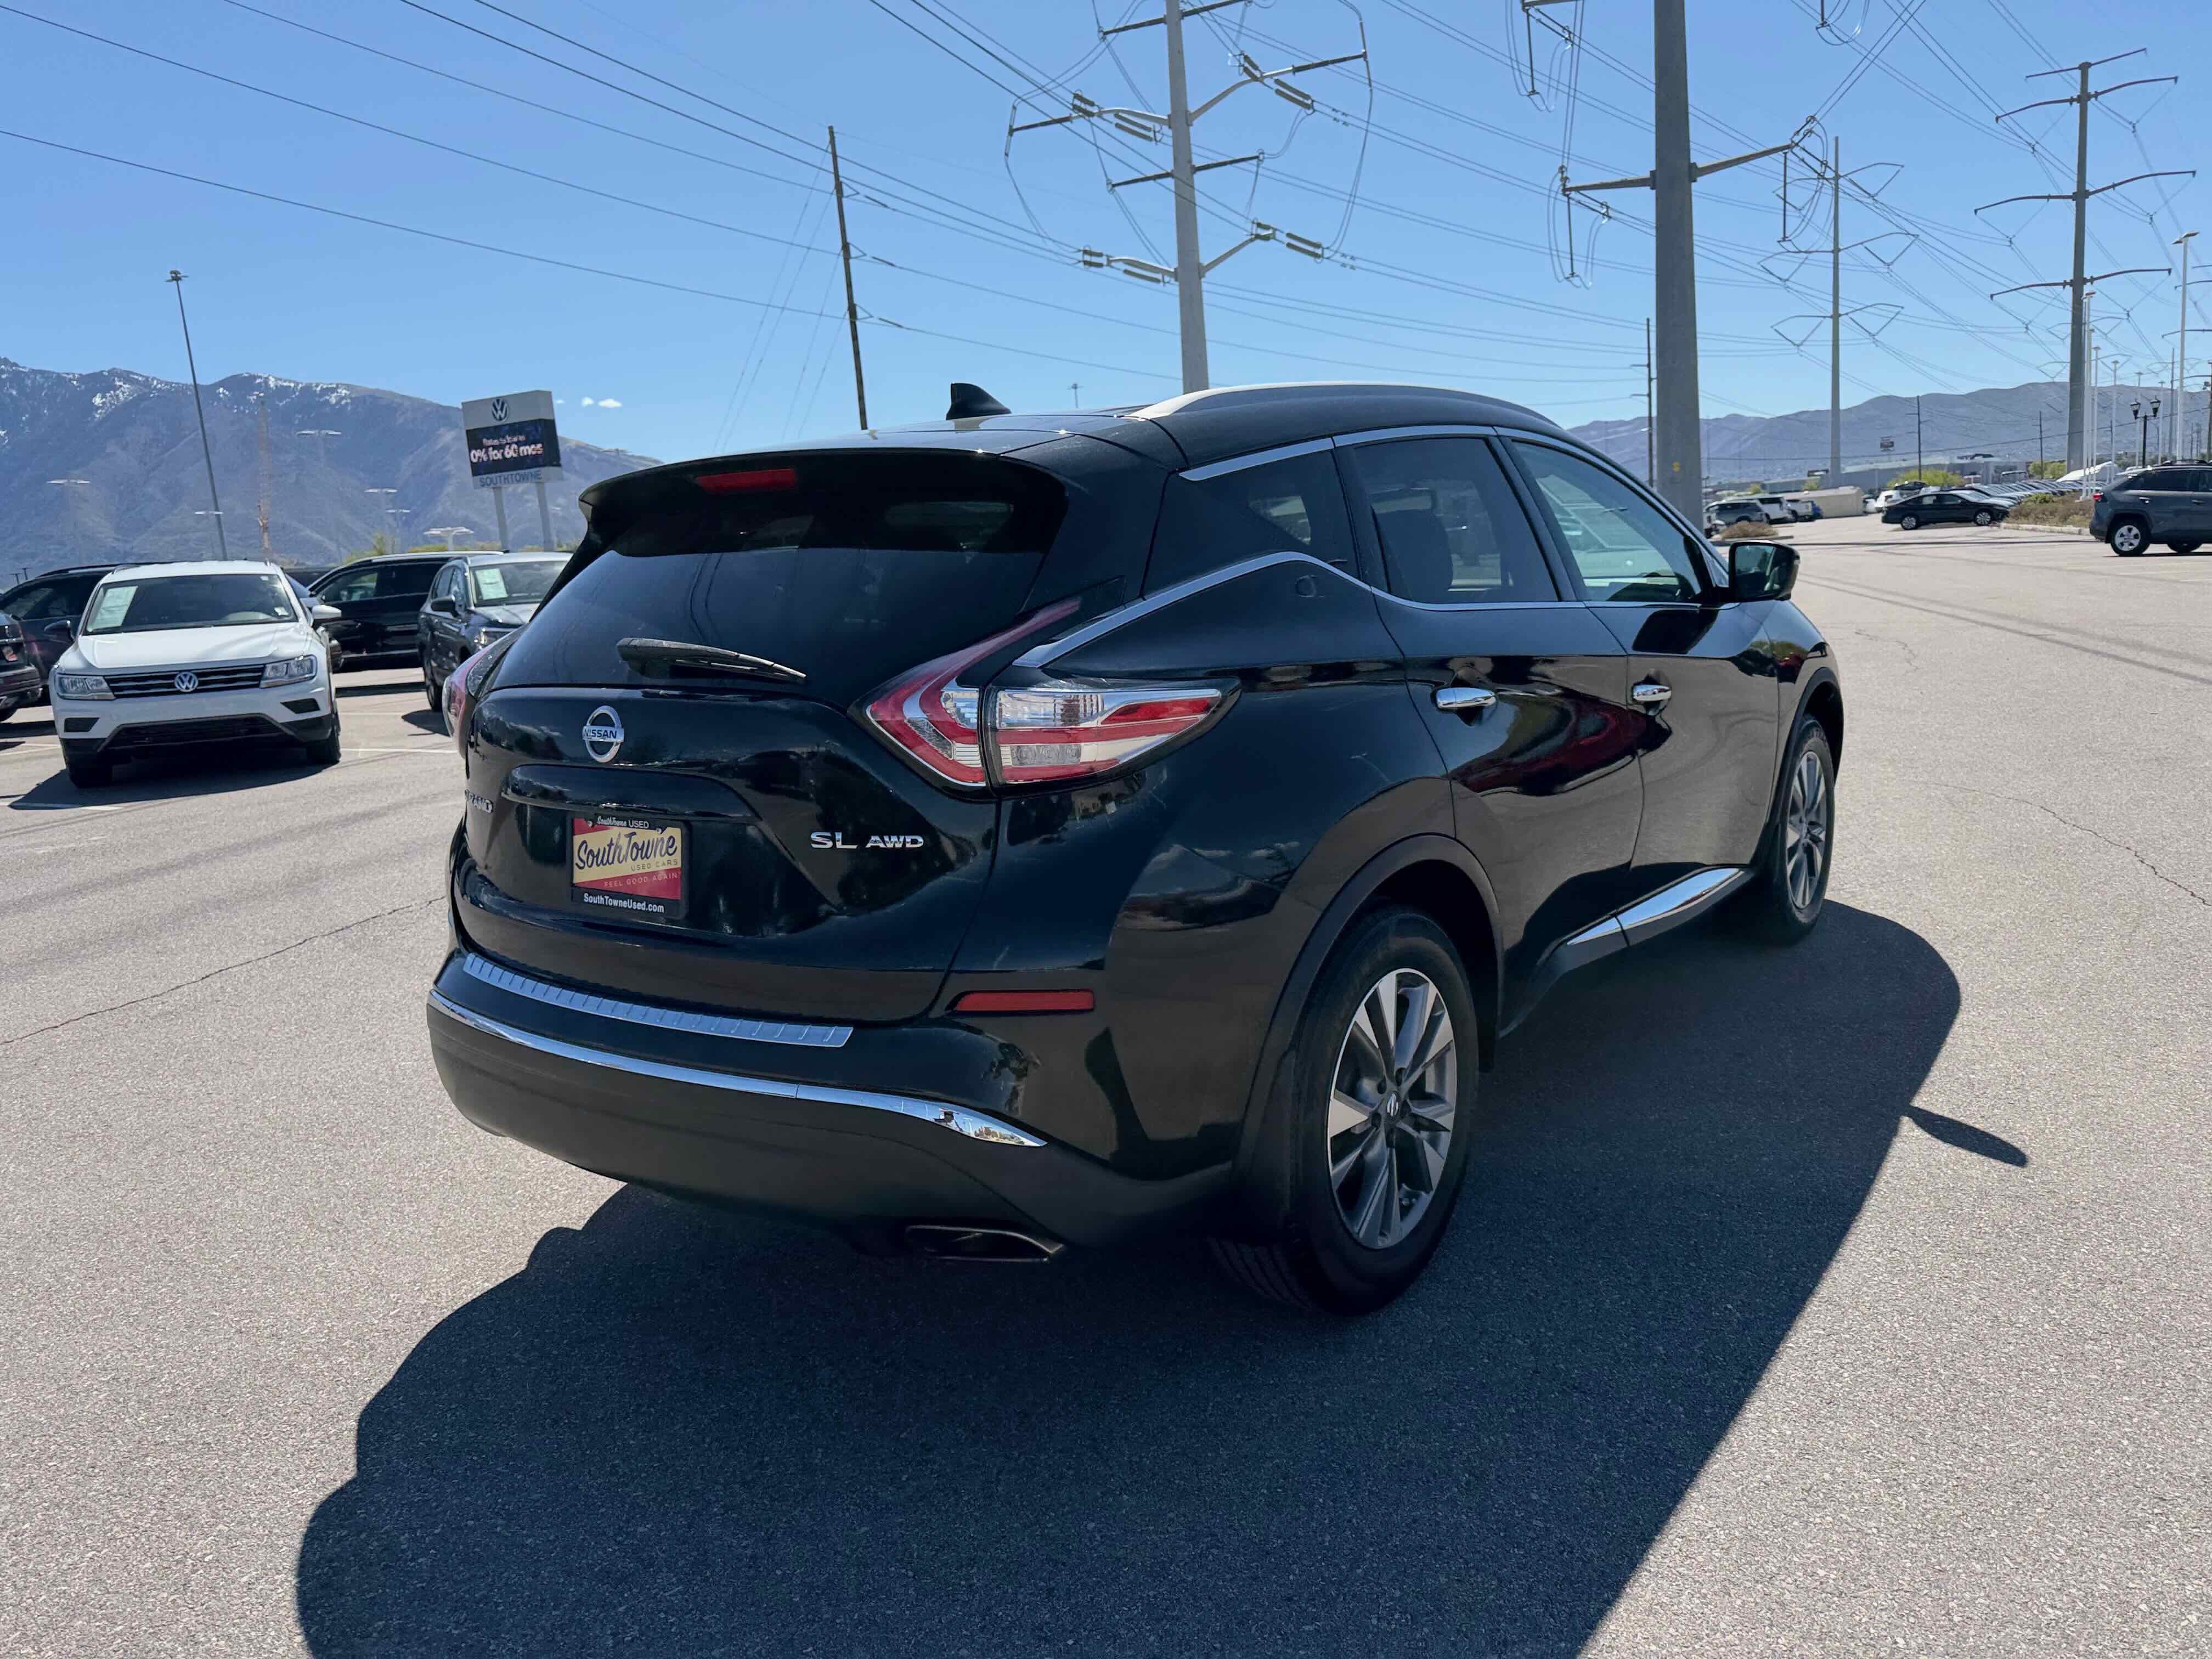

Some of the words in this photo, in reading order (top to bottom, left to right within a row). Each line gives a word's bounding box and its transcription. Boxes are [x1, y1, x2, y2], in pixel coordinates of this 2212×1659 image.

[470, 449, 488, 463] 0%
[488, 447, 503, 460] for
[504, 443, 518, 459] 60
[479, 470, 542, 487] SOUTHTOWNE
[583, 728, 617, 739] NISSAN
[628, 820, 650, 829] USED
[810, 831, 858, 849] SL
[865, 835, 924, 849] AWD
[575, 831, 678, 870] SouthTowne
[631, 863, 651, 872] USED
[656, 859, 678, 867] CARS
[626, 876, 648, 885] GOOD
[652, 872, 678, 882] AGAIN
[583, 893, 664, 913] SouthTowneUsed.com
